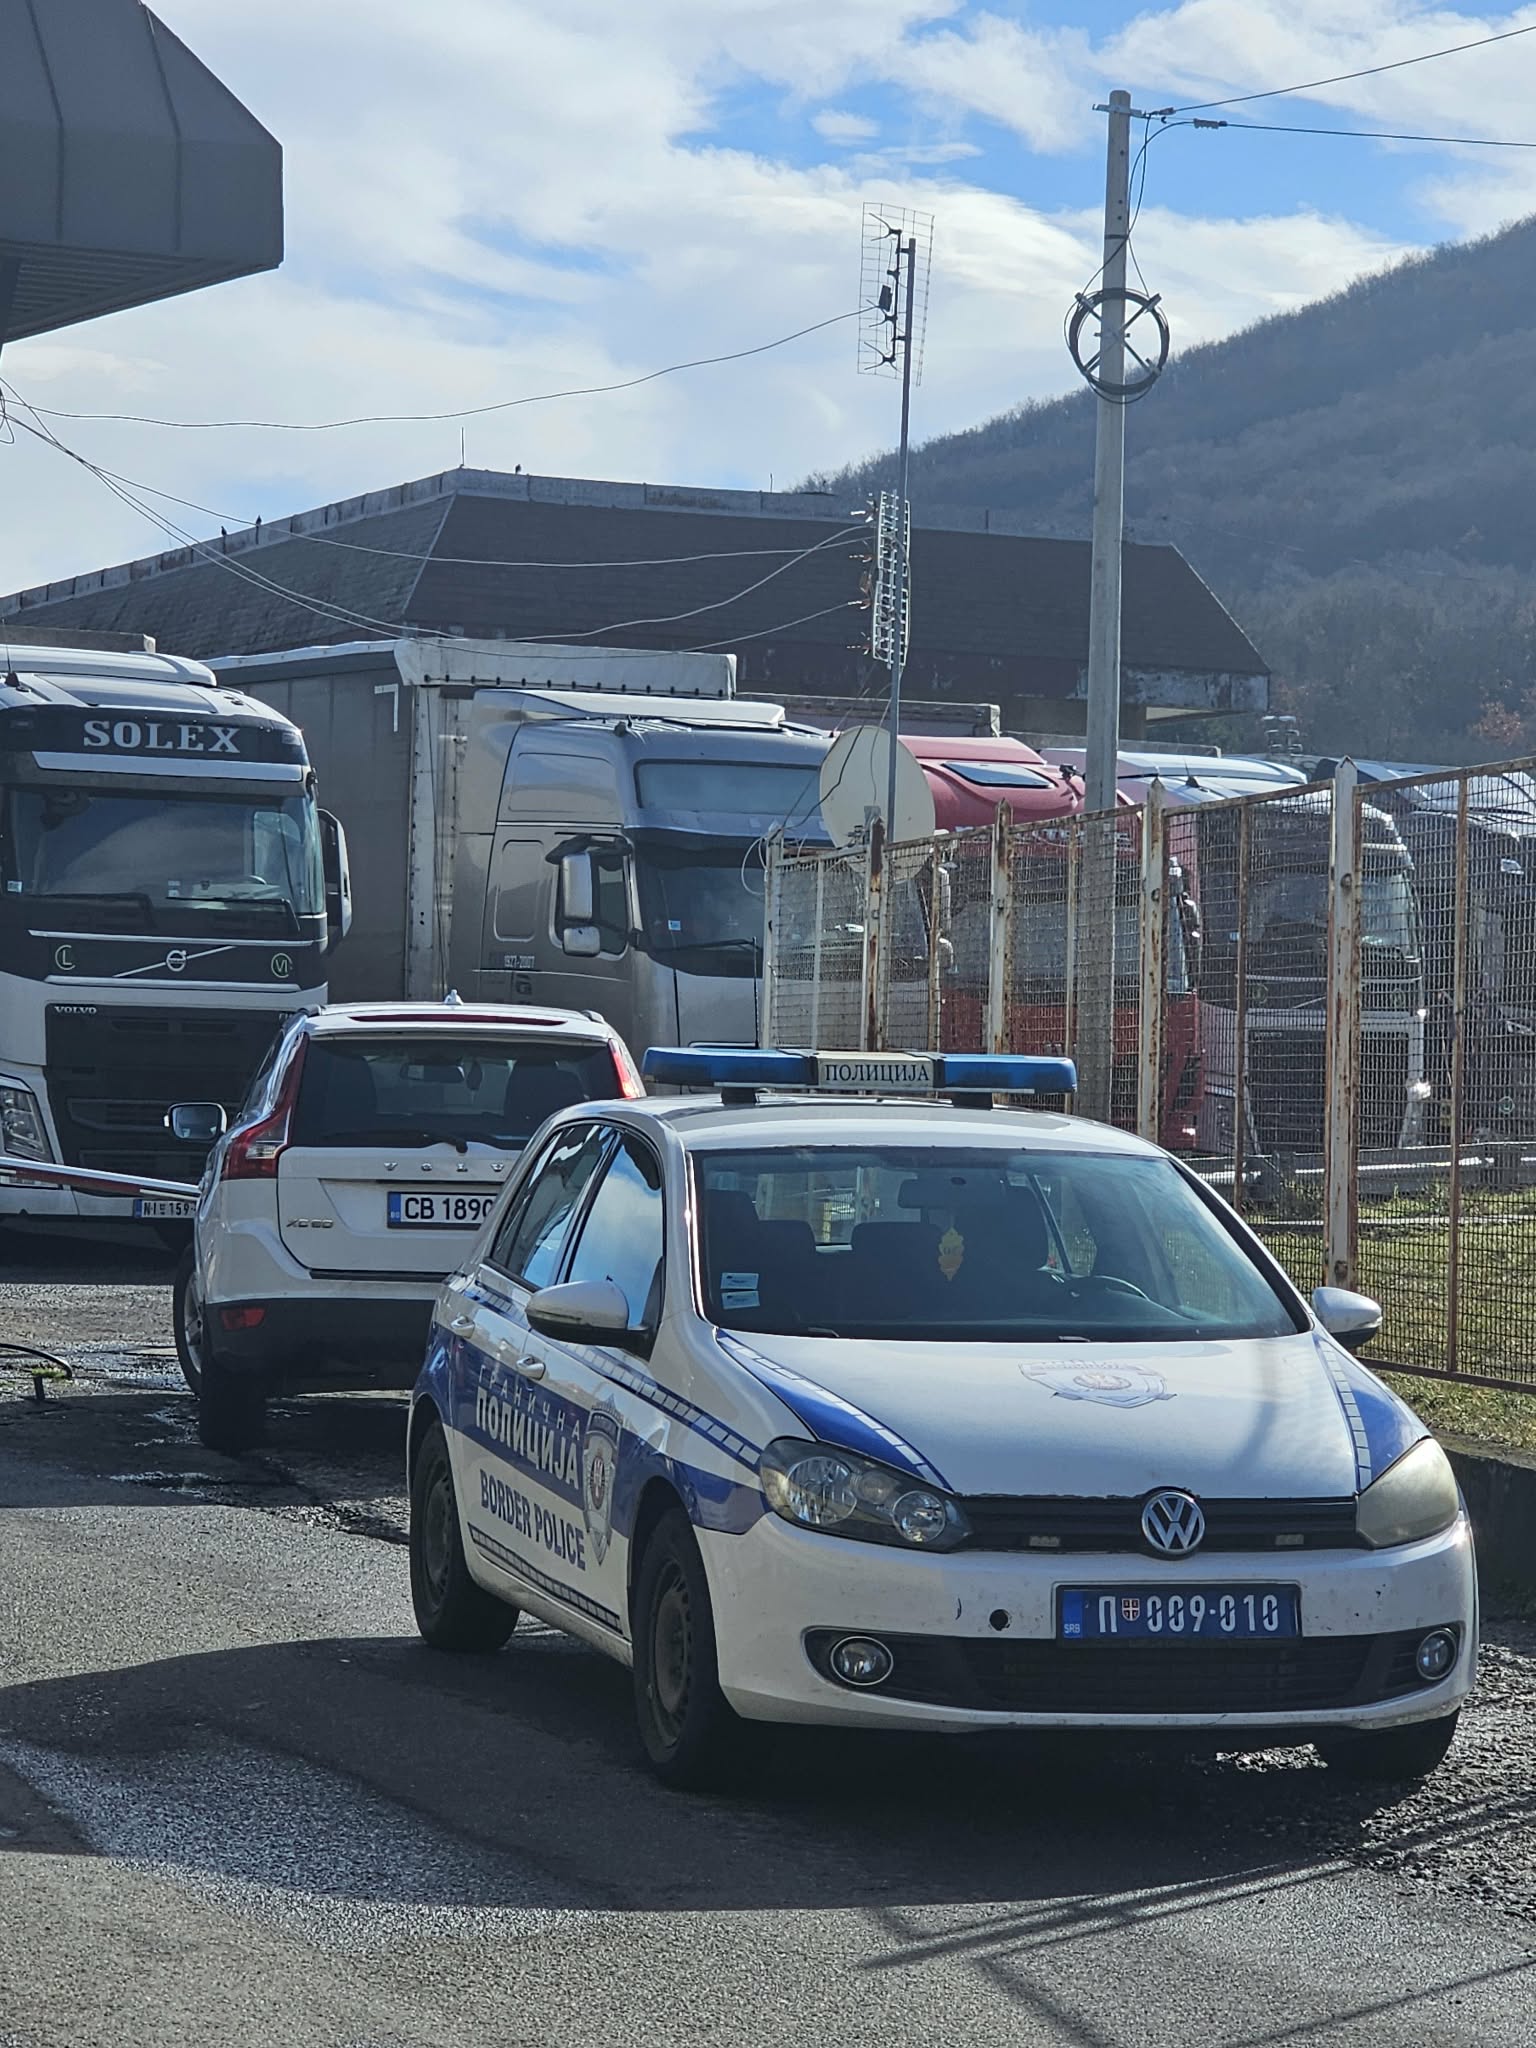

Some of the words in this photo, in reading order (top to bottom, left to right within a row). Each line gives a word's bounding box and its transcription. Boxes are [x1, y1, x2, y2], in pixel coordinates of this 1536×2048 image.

[83, 720, 240, 754] SOLEX
[54, 1006, 97, 1014] VOLVO
[825, 1064, 929, 1083] ПОЛИЦИЈА
[384, 1162, 504, 1172] VOLV
[405, 1197, 434, 1219] CB
[479, 1365, 580, 1441] ГРАНИЧНА
[475, 1386, 579, 1490] ПОЛИЦИЈА
[480, 1468, 532, 1538] BORDER
[533, 1503, 586, 1571] POLICE
[1063, 1624, 1081, 1634] SRB
